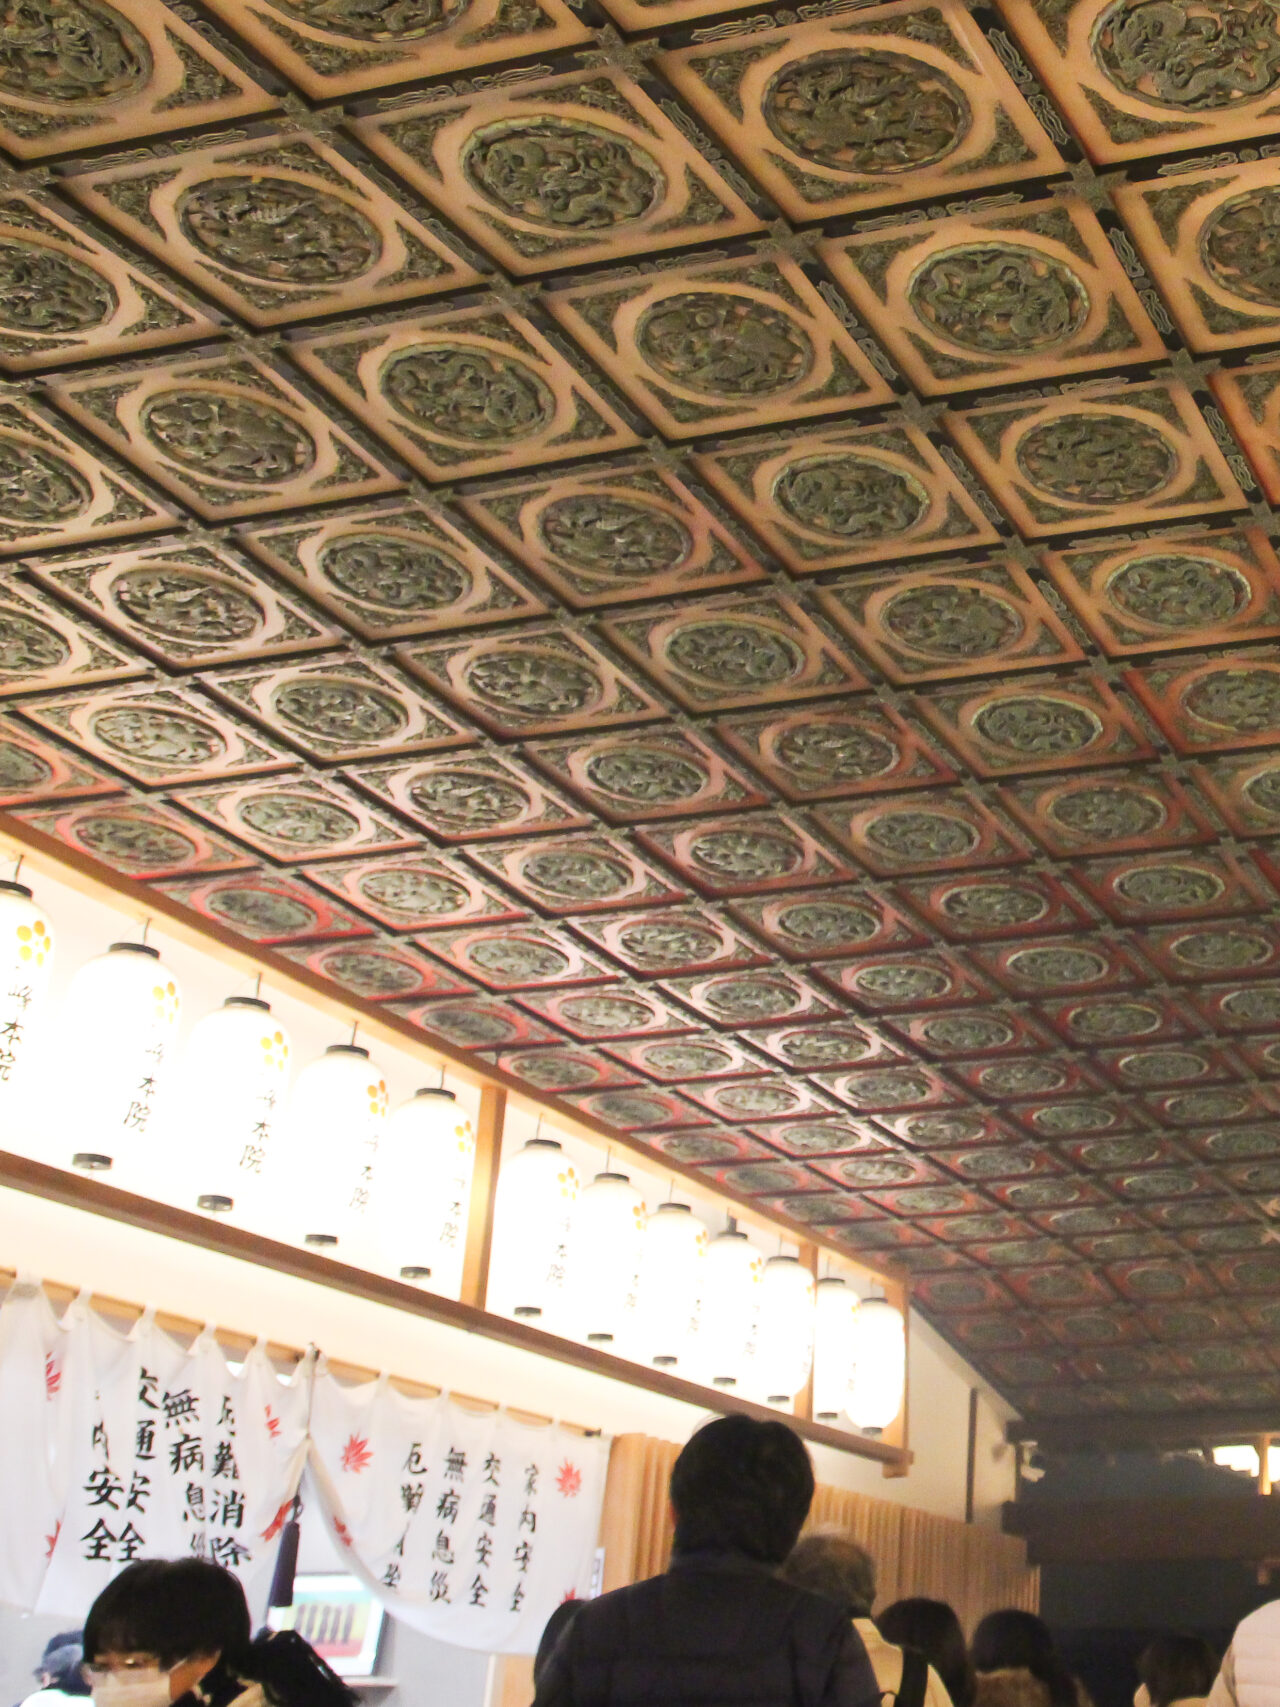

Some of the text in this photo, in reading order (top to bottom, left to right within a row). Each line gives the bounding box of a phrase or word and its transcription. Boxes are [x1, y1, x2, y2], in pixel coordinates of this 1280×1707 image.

[81, 1390, 124, 1562] 内安全
[430, 1447, 467, 1604] 無病息災
[470, 1451, 501, 1608] 交通安全
[510, 1464, 539, 1612] 家内安全
